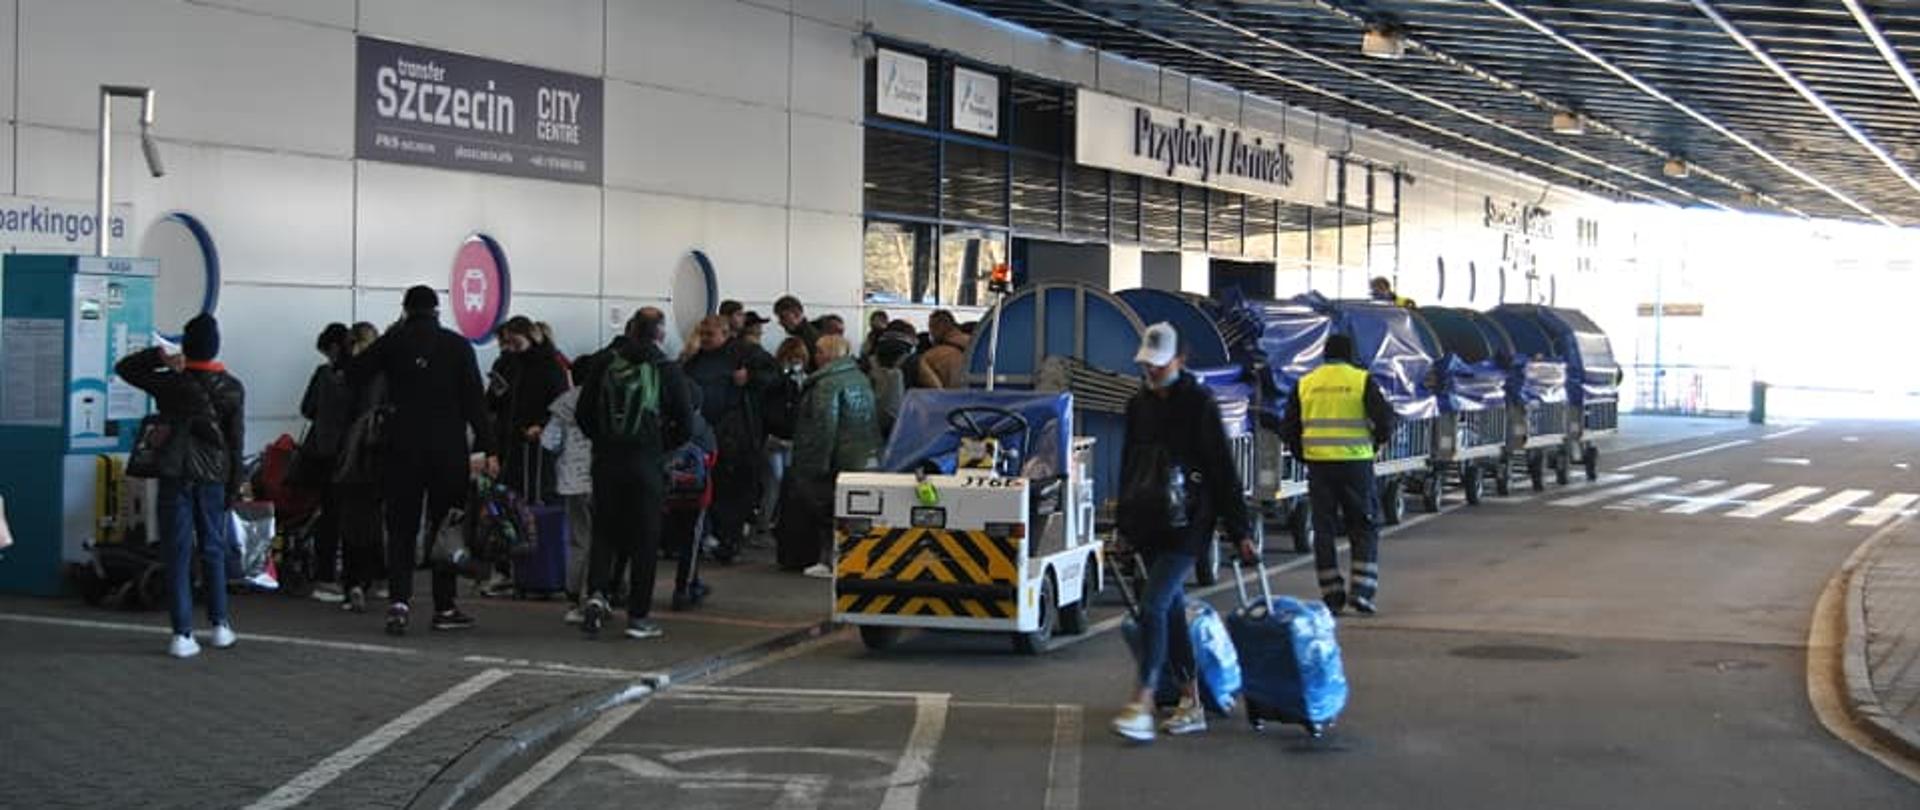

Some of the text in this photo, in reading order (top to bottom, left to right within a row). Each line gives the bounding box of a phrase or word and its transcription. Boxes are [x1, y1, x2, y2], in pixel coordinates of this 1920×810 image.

[397, 59, 446, 82] transfer
[376, 66, 514, 135] Szczecin
[537, 86, 581, 123] CITY
[537, 121, 581, 144] CENTRE
[1228, 131, 1294, 186] Arrivals
